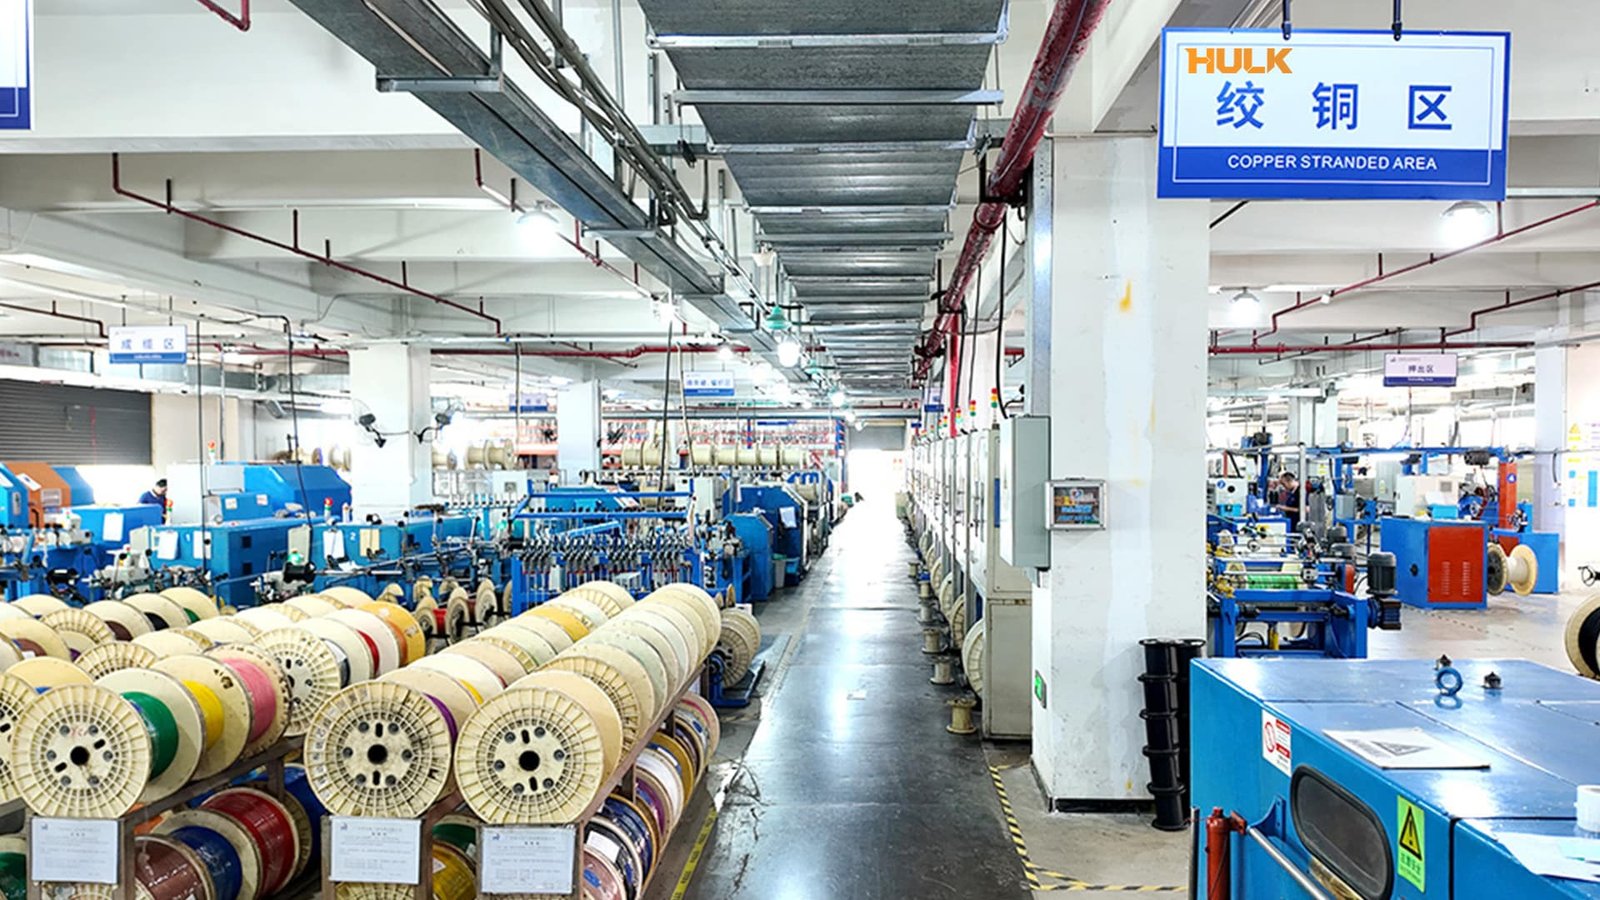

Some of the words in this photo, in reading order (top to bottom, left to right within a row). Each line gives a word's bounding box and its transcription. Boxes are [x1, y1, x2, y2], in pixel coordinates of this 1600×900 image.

[1216, 80, 1453, 131] 绞铜区
[1227, 154, 1297, 169] COPPER
[1300, 155, 1390, 170] STRANDED
[1392, 156, 1437, 170] AREA
